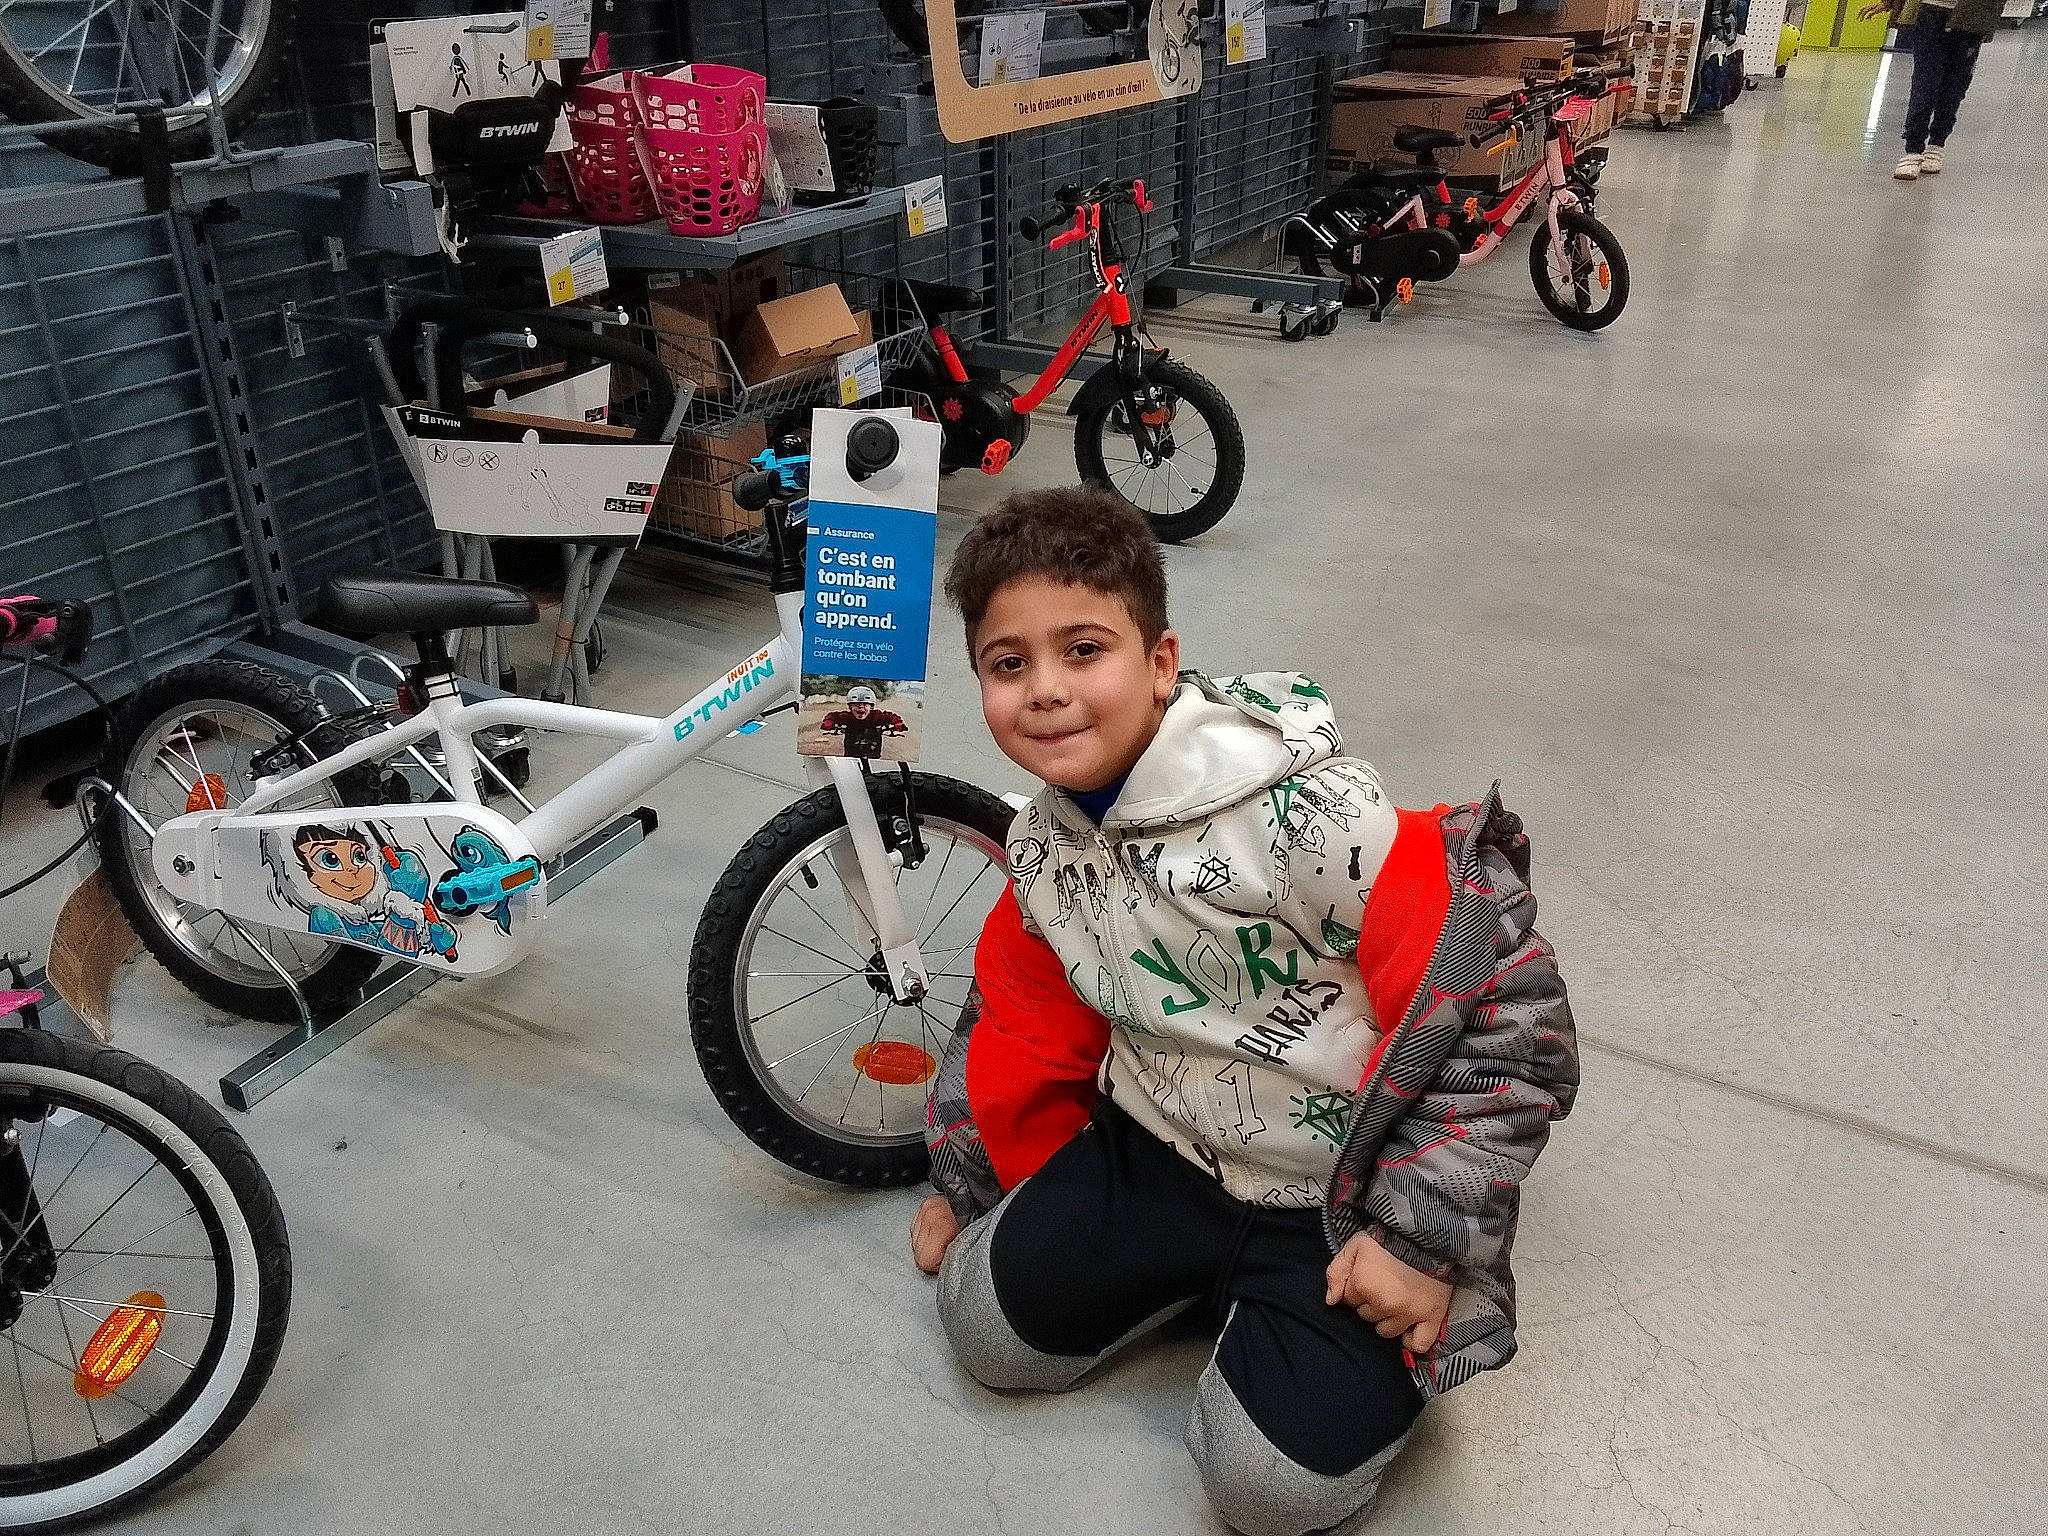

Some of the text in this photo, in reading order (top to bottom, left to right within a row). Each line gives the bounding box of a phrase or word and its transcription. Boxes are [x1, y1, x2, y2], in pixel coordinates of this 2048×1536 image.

[1521, 58, 1541, 69] 900
[1030, 100, 1037, 113] la
[1038, 96, 1073, 112] draisienne
[1073, 94, 1082, 105] au
[1083, 88, 1097, 103] vélo
[1097, 90, 1106, 99] en
[1106, 87, 1115, 98] un
[1115, 83, 1127, 97] clin
[1466, 108, 1487, 119] 500
[430, 416, 461, 428] BTWIN
[823, 526, 876, 540] Assurance
[818, 547, 896, 570] C'est en
[817, 568, 897, 591] tombant
[816, 588, 867, 609] qu'on
[815, 611, 898, 630] apprend.
[814, 636, 894, 652] Protégez son vélo
[813, 650, 889, 663] contre les bobos
[726, 649, 769, 684] INUIT 100
[1233, 978, 1346, 1067] PARIS
